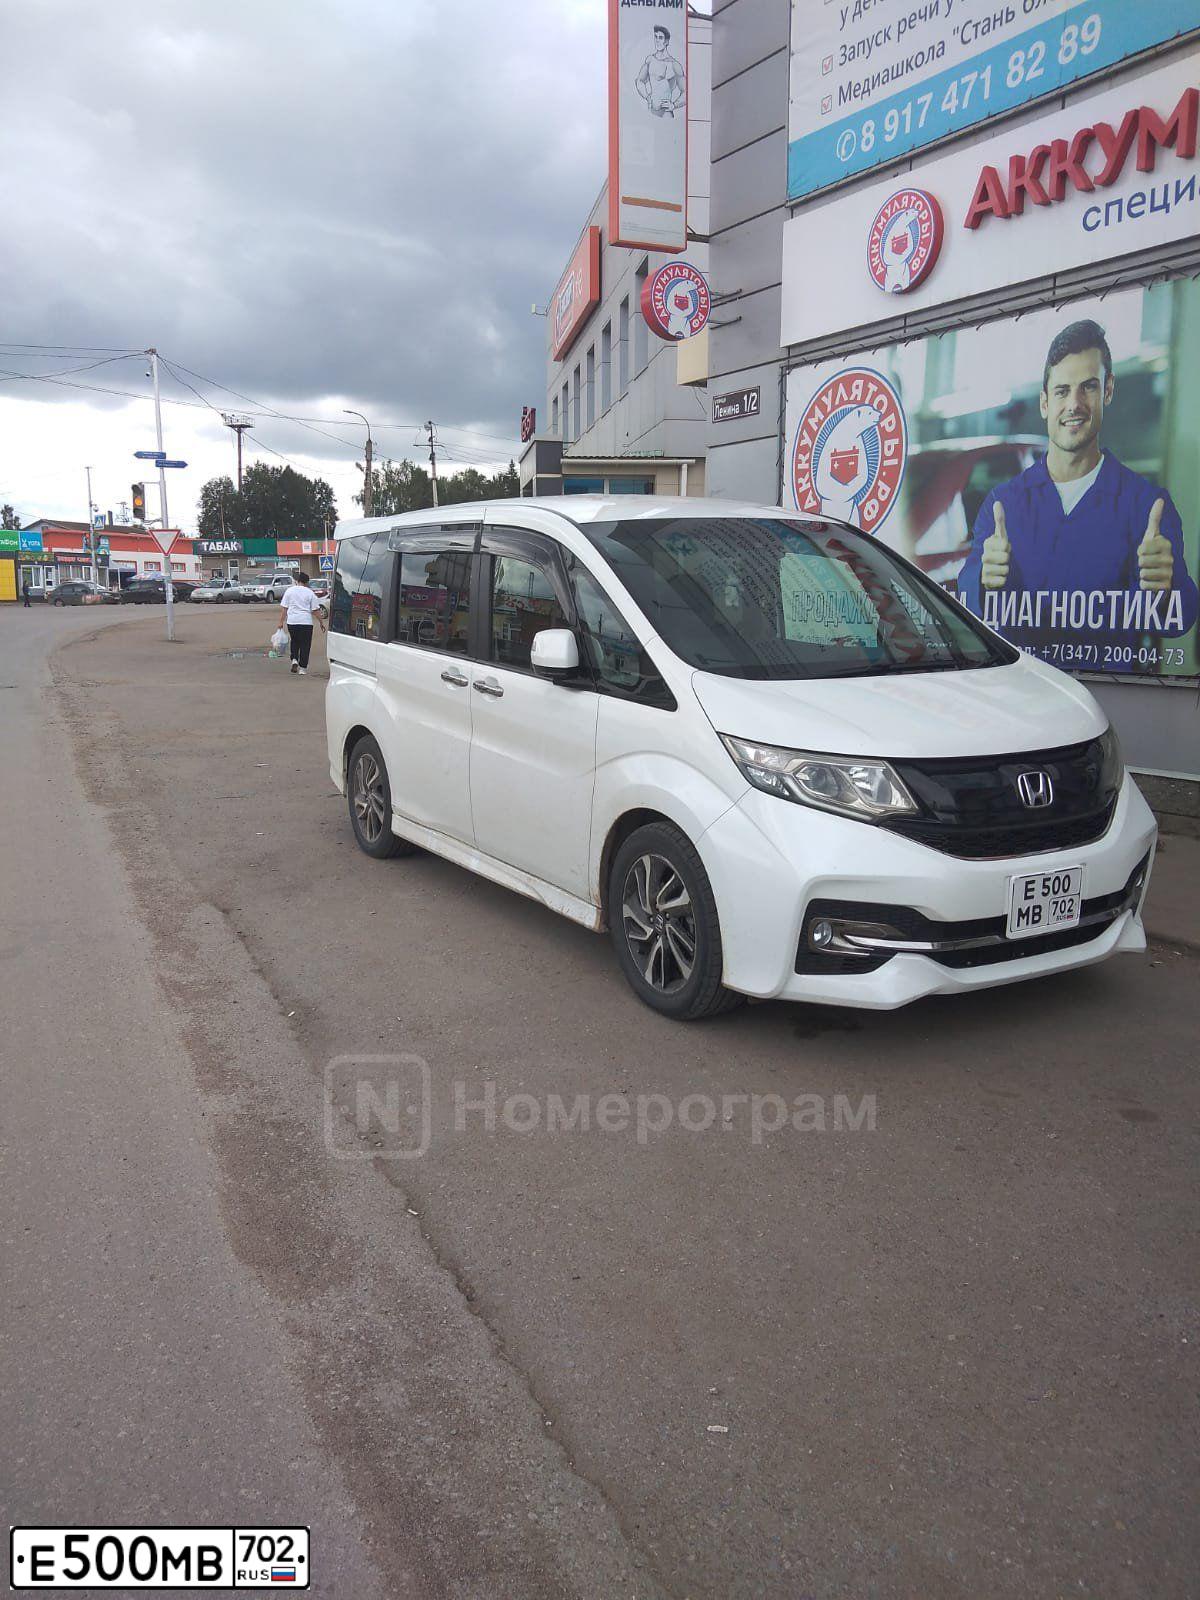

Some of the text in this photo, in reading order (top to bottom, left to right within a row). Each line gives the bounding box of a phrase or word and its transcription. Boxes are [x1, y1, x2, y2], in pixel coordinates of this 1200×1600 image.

[838, 24, 892, 67] Запуск
[897, 0, 939, 42] речи
[838, 41, 946, 106] Медиашкола
[952, 5, 1015, 45] "Стань
[860, 14, 1101, 153] 8 917 471 82 89
[964, 87, 1200, 229] АККУМ
[1082, 175, 1200, 232] специ
[743, 391, 758, 413] 1/2
[201, 541, 238, 551] ТАБАК
[983, 590, 1184, 631] ДИАГНОСТИКА
[1041, 643, 1099, 662] +7(347)
[1104, 646, 1185, 665] 200-04-73
[1041, 874, 1071, 897] 500
[1017, 899, 1074, 928] МВ 702
